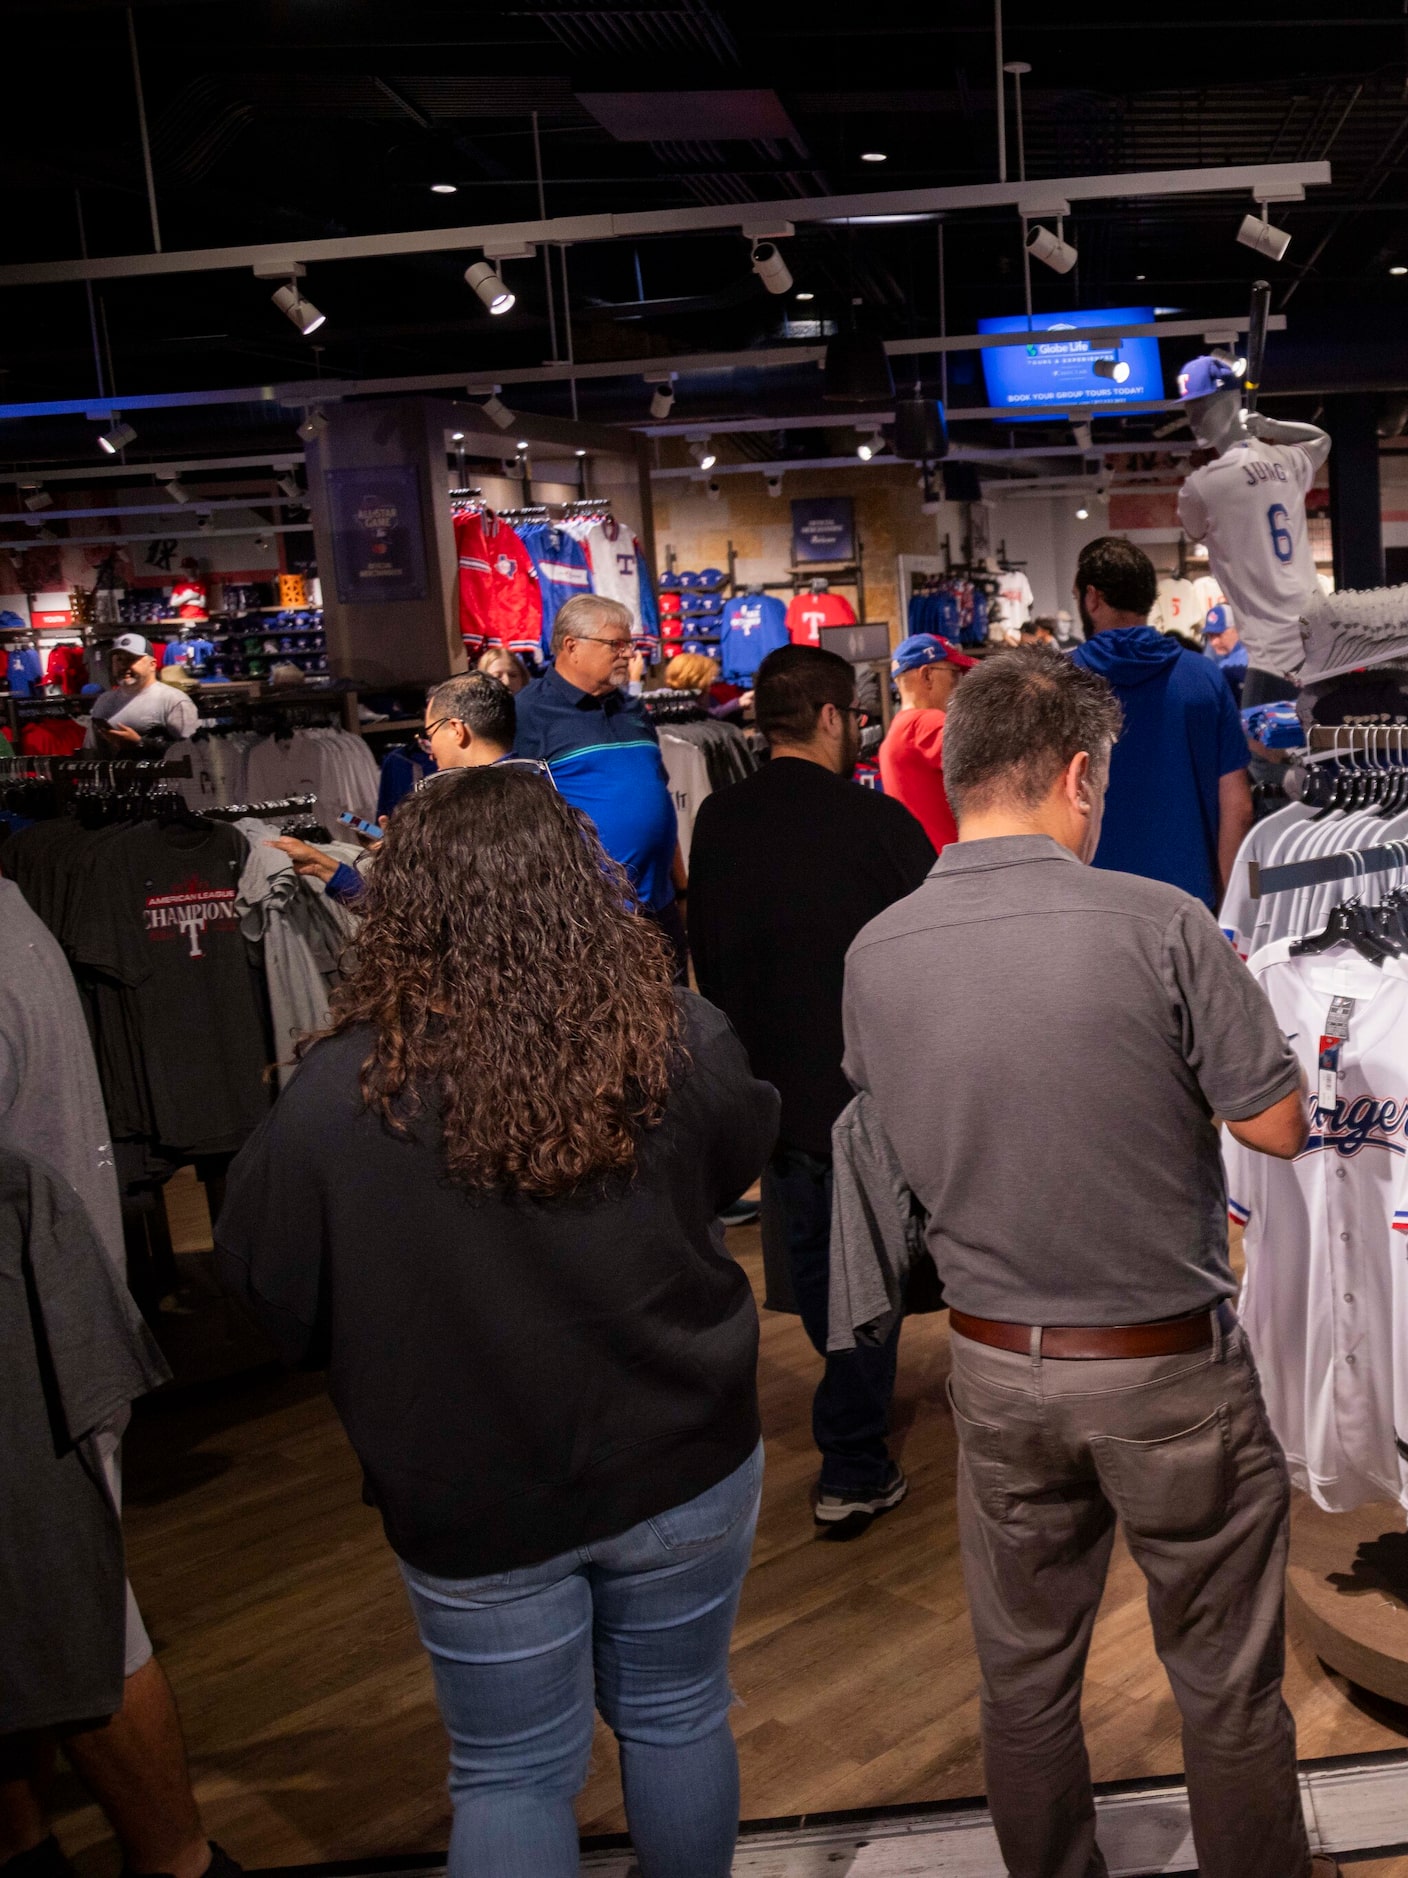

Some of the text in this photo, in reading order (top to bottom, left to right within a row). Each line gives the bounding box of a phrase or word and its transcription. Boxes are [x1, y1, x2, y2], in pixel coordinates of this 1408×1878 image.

[1039, 341, 1089, 355] Globe Life
[1008, 394, 1031, 403] BOOK
[1032, 393, 1055, 401] YOUR
[1056, 391, 1084, 400] GROUP
[1086, 389, 1112, 397] TOURS
[1114, 387, 1144, 396] TODAY!
[1242, 461, 1288, 486] JUNG
[1267, 503, 1293, 565] 6
[617, 554, 636, 575] T
[803, 612, 826, 639] T
[923, 646, 936, 659] T
[147, 889, 235, 906] AMERICAN LEAGUE
[180, 918, 204, 956] T
